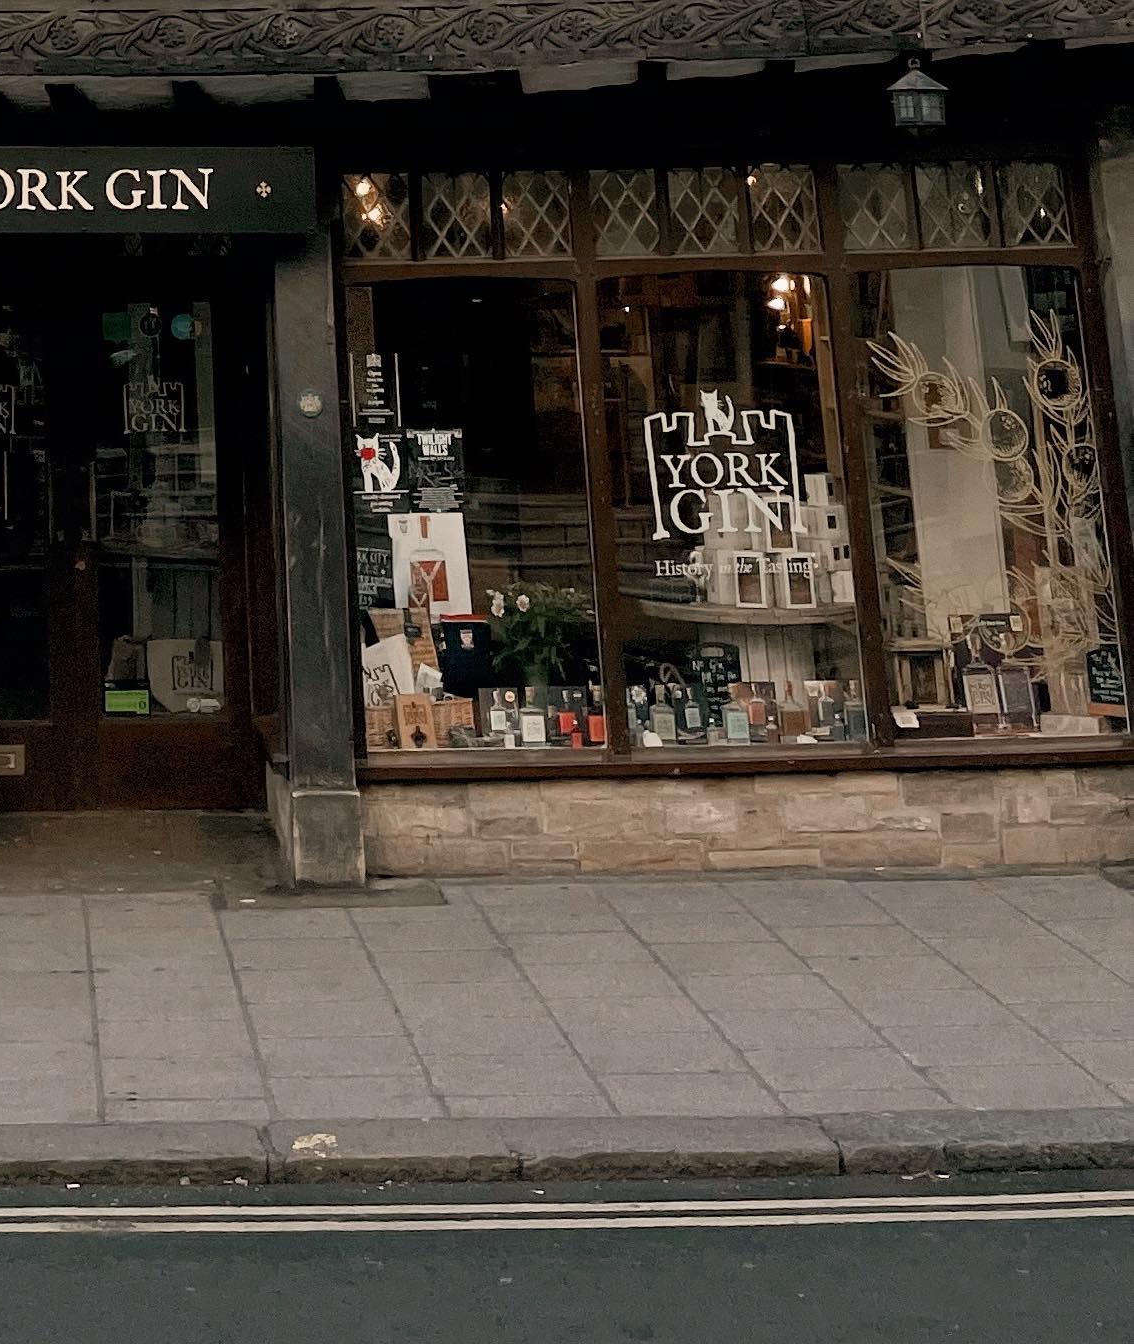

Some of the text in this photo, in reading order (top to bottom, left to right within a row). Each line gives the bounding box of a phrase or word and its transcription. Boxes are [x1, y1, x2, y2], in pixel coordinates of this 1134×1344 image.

[105, 168, 214, 211] GIN
[129, 398, 180, 415] YORK
[131, 413, 178, 432] GIN
[660, 452, 789, 488] YORK
[670, 486, 785, 534] GIN
[654, 559, 714, 581] History
[755, 556, 811, 579] Tasing
